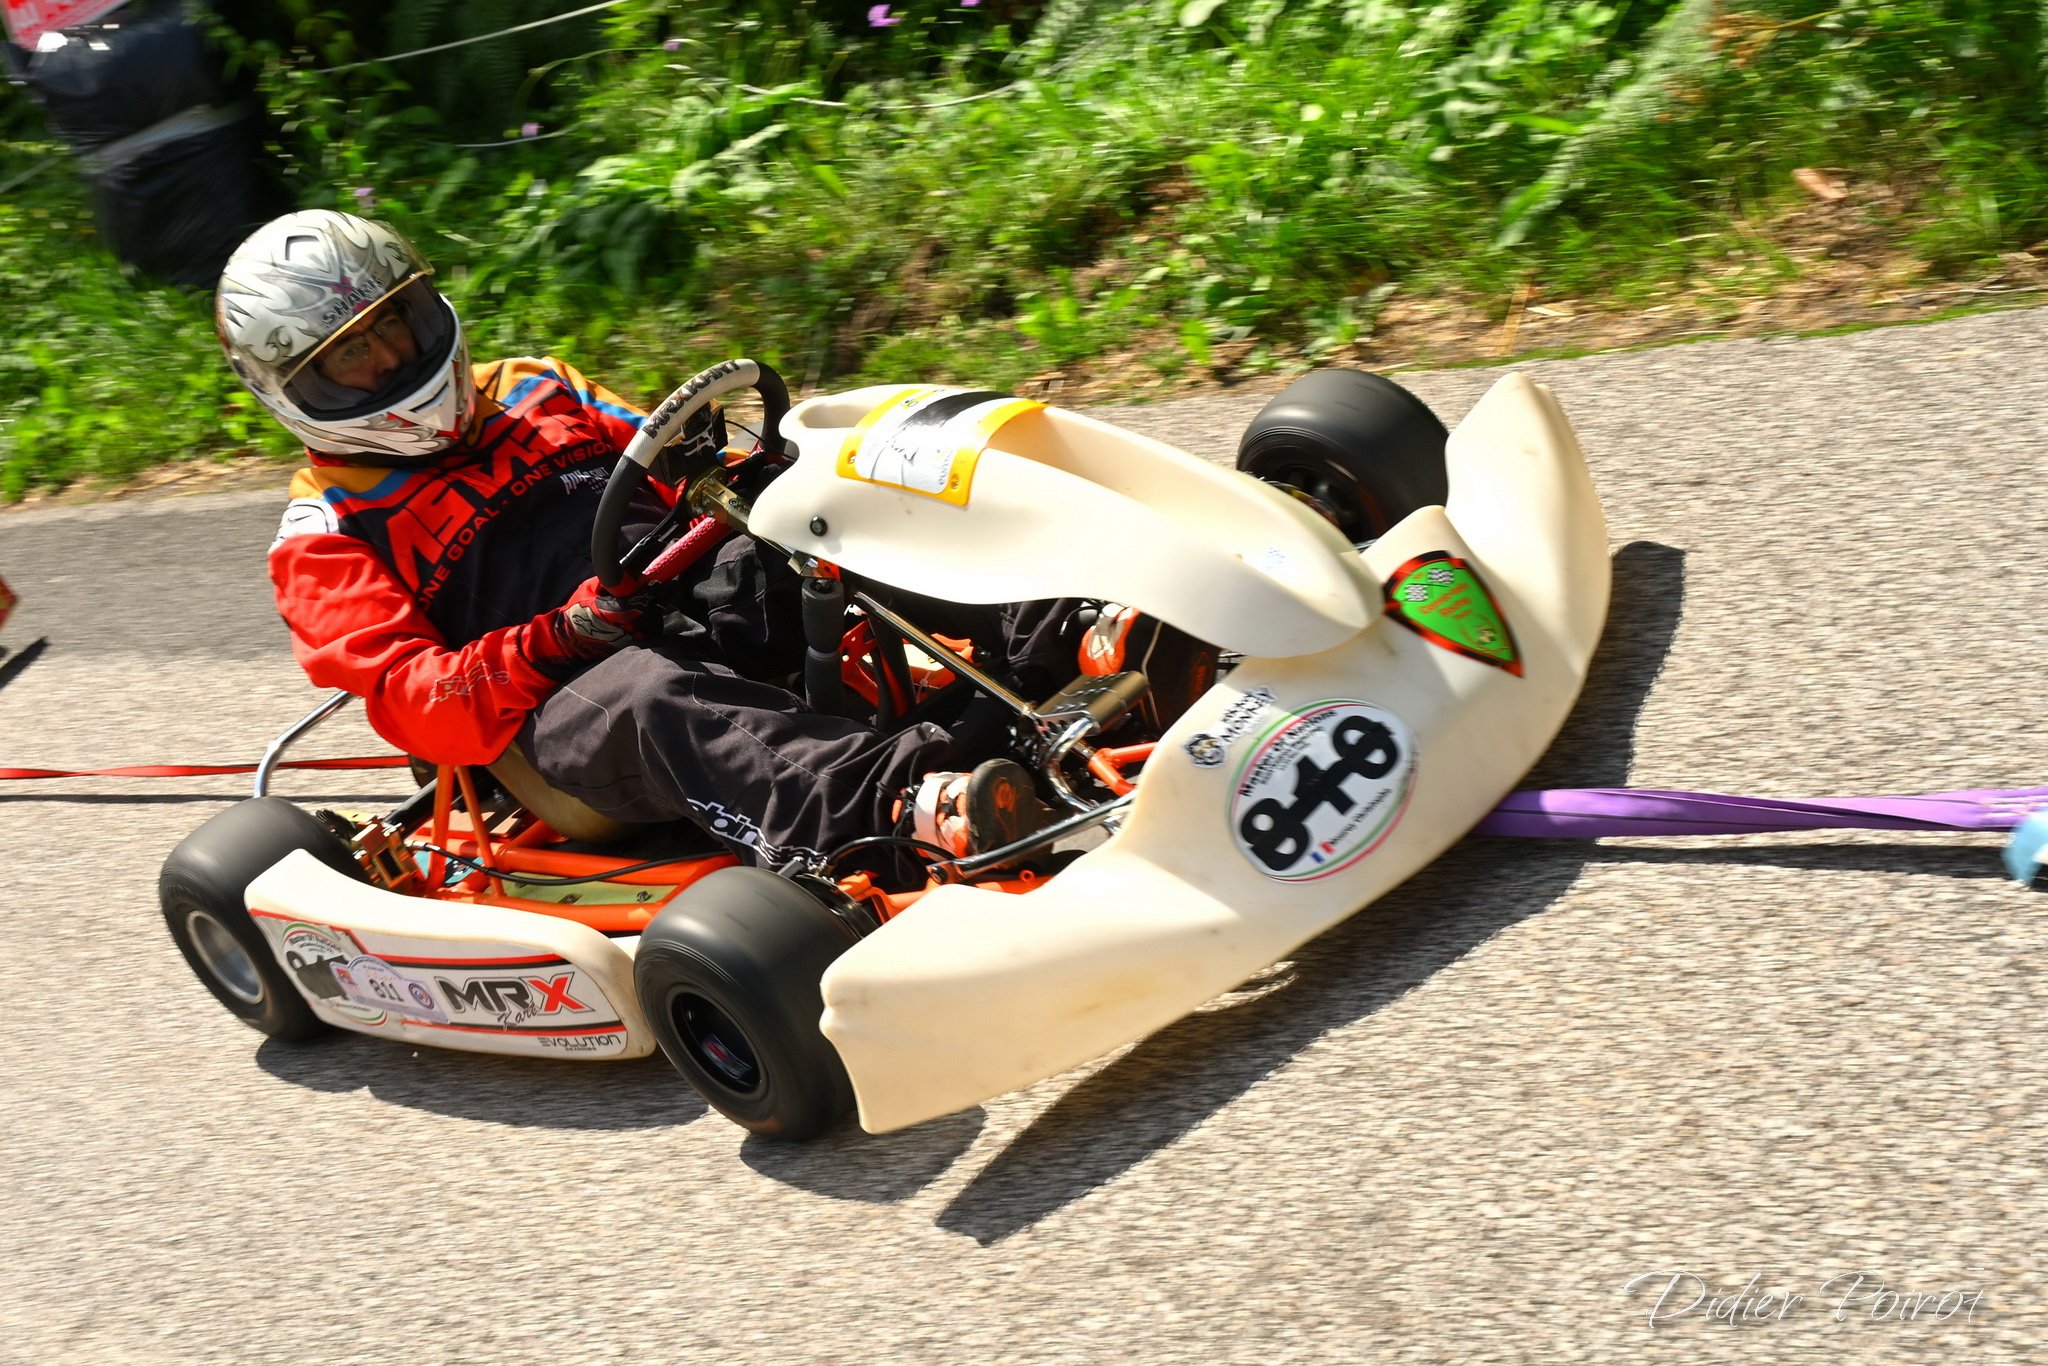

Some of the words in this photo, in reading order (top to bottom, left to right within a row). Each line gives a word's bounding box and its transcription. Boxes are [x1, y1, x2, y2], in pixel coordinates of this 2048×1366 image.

[321, 274, 386, 326] SHARK
[447, 505, 500, 561] GOAL
[511, 461, 551, 496] ONE
[553, 441, 611, 469] VISIO
[437, 974, 588, 1013] MRX
[497, 1002, 540, 1031] Kart
